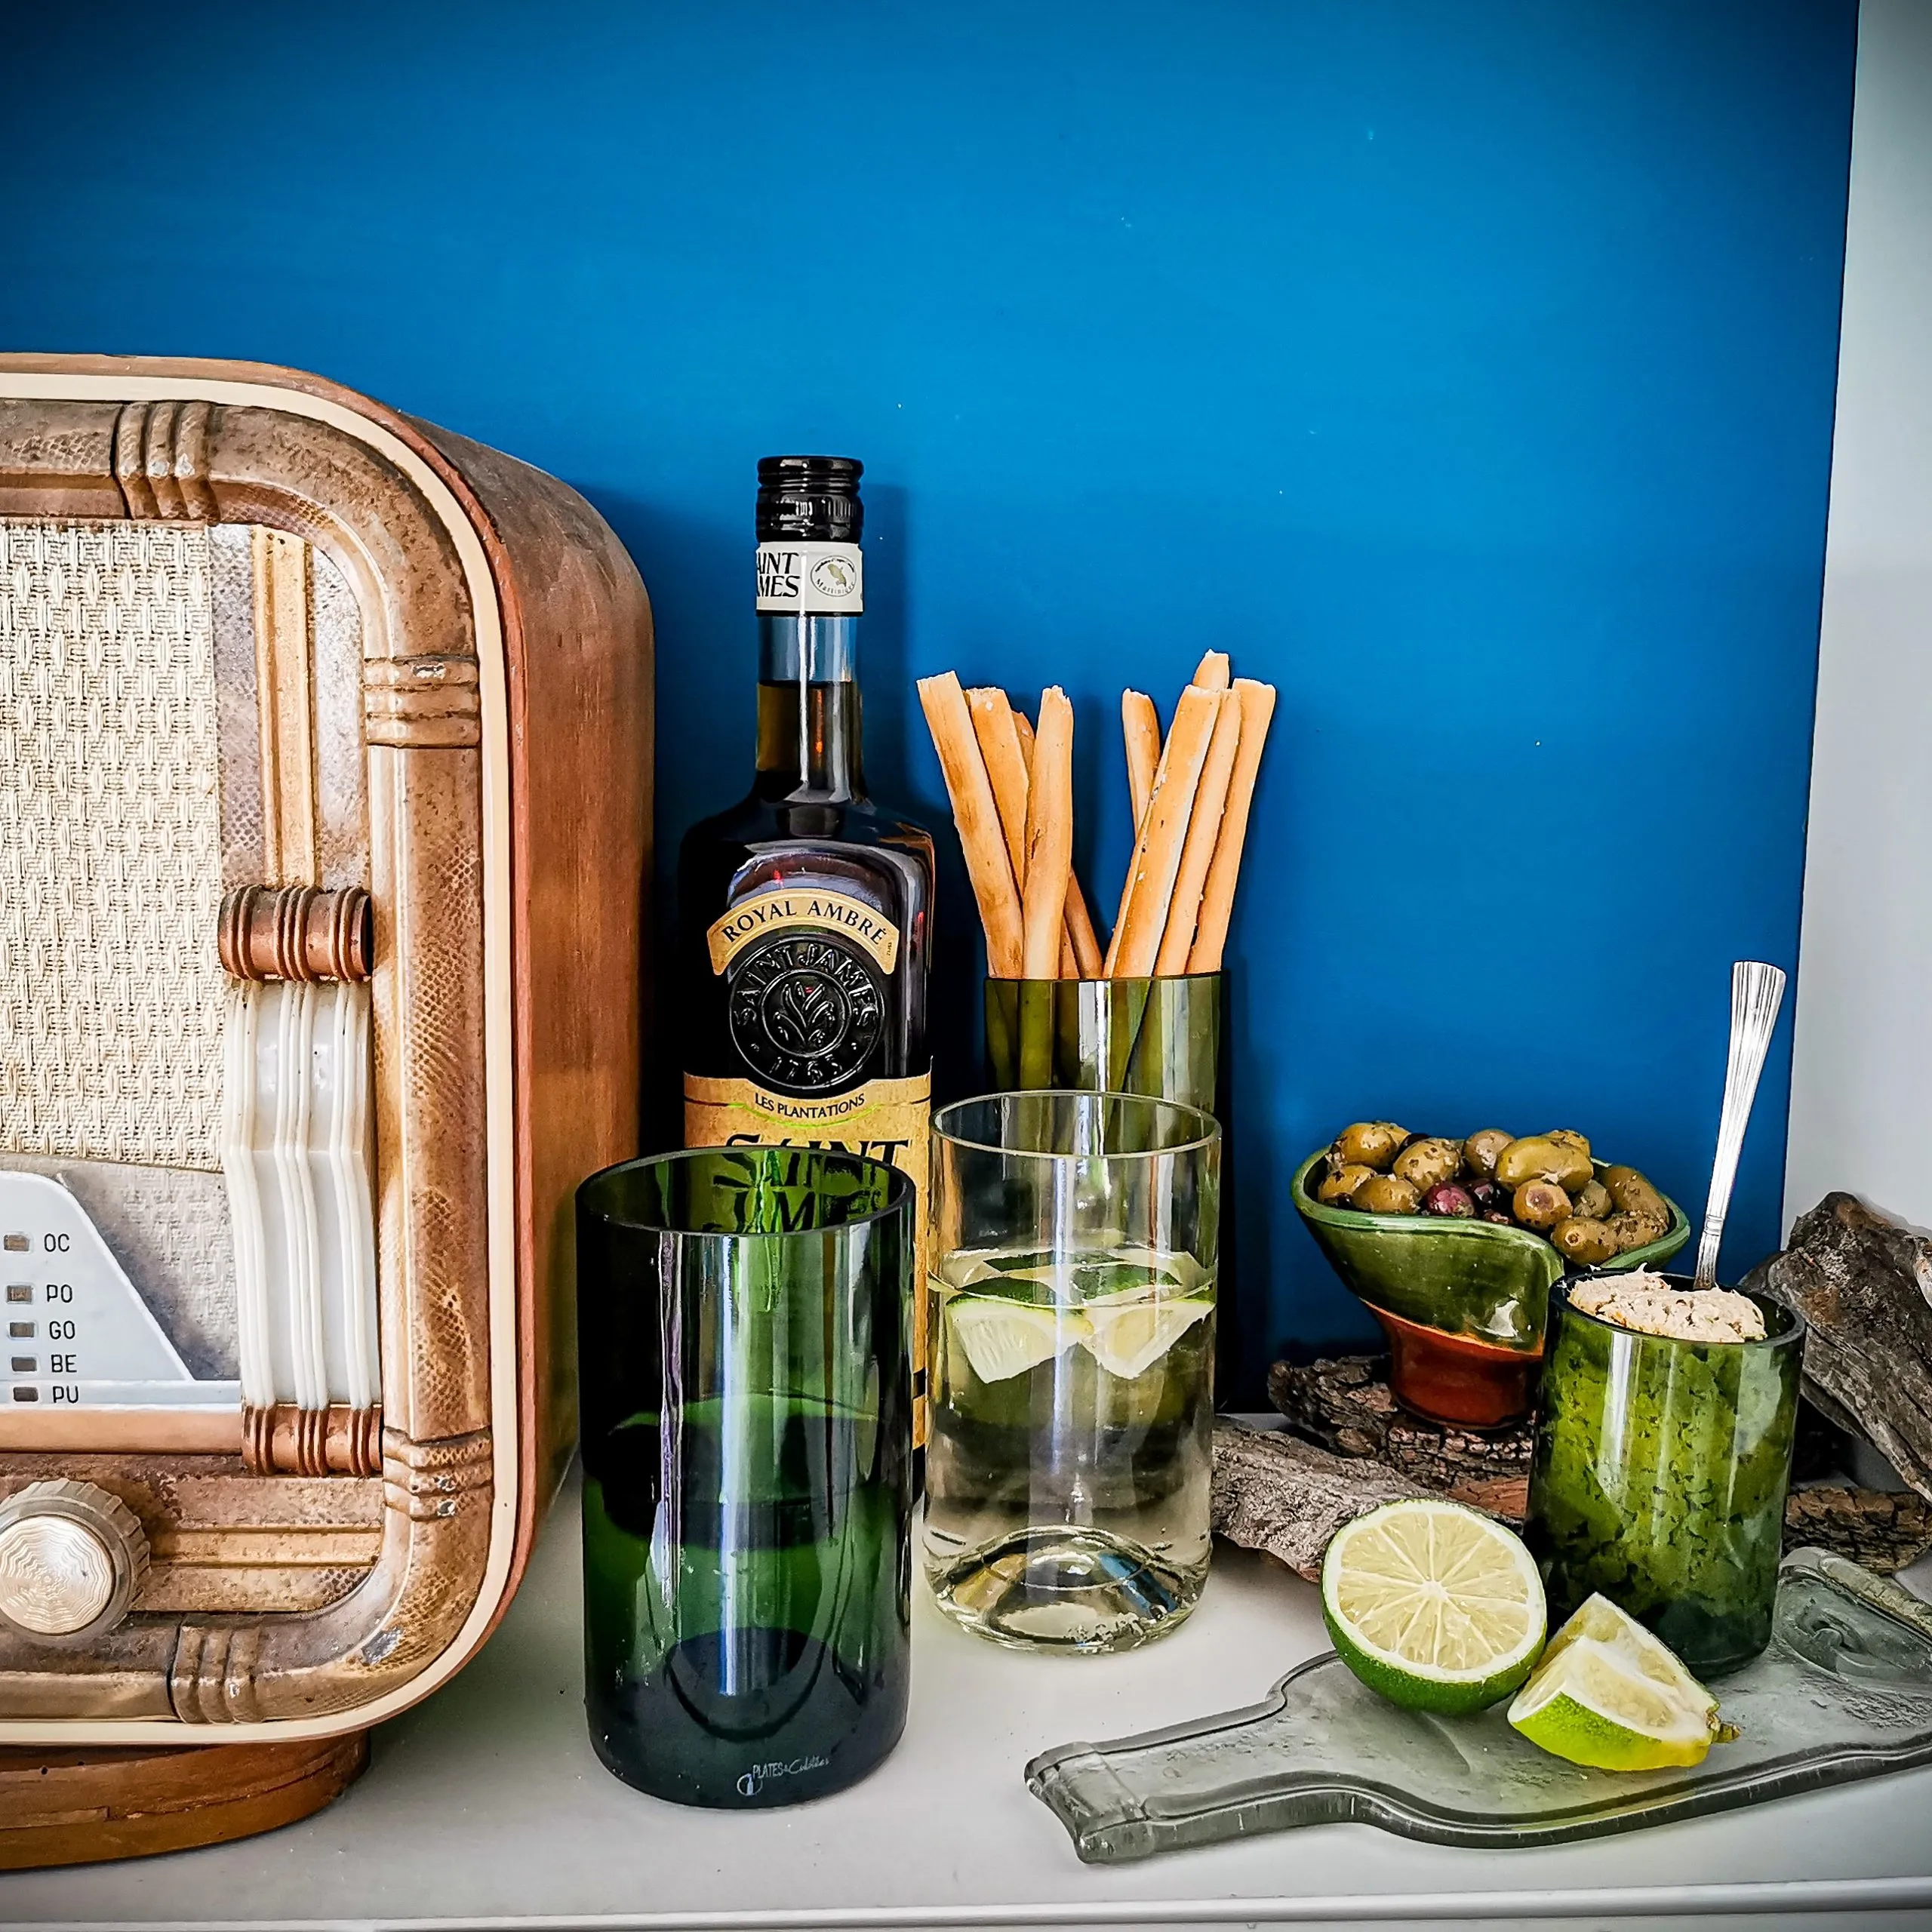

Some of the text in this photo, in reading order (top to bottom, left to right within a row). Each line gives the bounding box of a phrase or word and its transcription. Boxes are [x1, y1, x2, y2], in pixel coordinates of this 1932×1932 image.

[756, 575, 801, 597] MES
[721, 900, 888, 945] ROYAL AMBRÉ
[734, 943, 879, 1026] SAINT JAMES
[755, 1093, 866, 1118] LES PLANTATIONS
[44, 1233, 70, 1252] OC
[46, 1284, 73, 1303] PO
[49, 1321, 75, 1340] GO
[51, 1354, 78, 1373] BE
[52, 1386, 79, 1404] PU
[752, 1761, 783, 1780] PLATES
